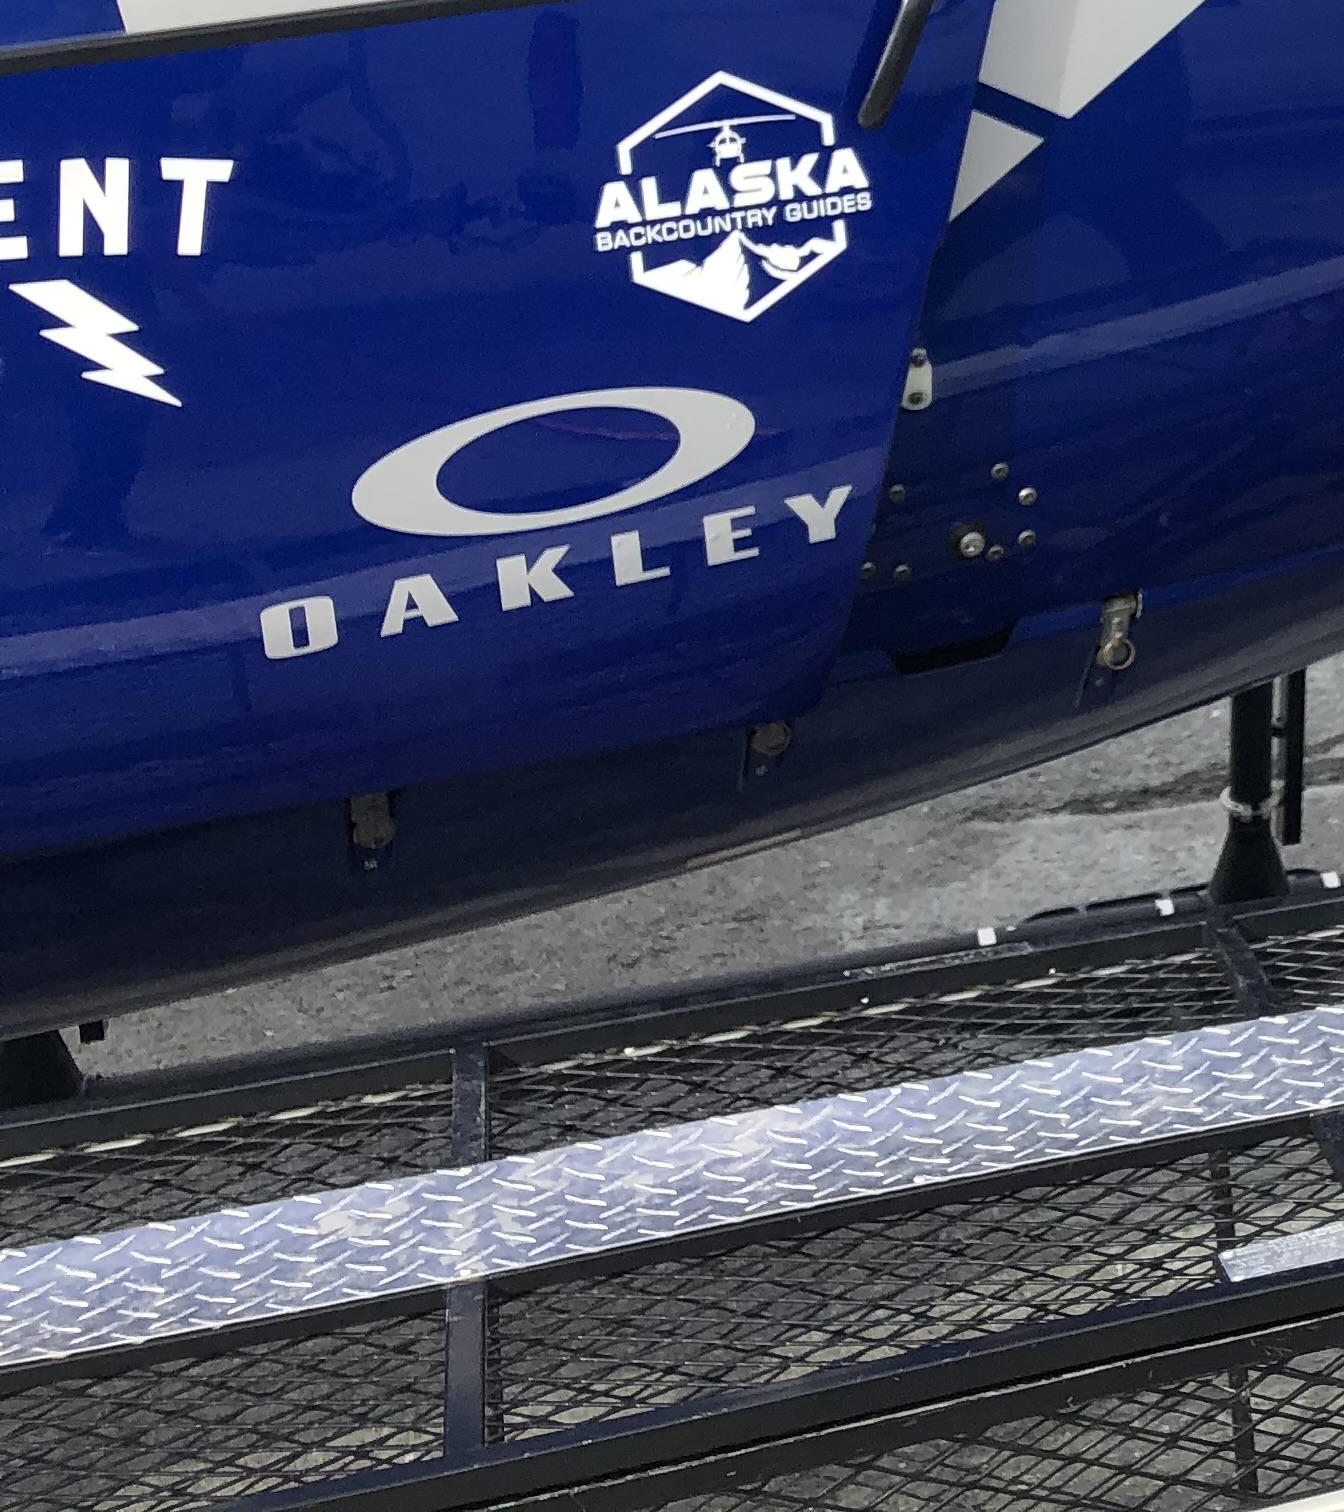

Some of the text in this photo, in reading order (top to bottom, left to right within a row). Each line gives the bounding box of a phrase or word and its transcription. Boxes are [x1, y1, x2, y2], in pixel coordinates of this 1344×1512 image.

[594, 192, 872, 252] BACKCOUNTRY GUIDES
[595, 147, 869, 228] ALASKA
[260, 485, 853, 660] OAKLEY
